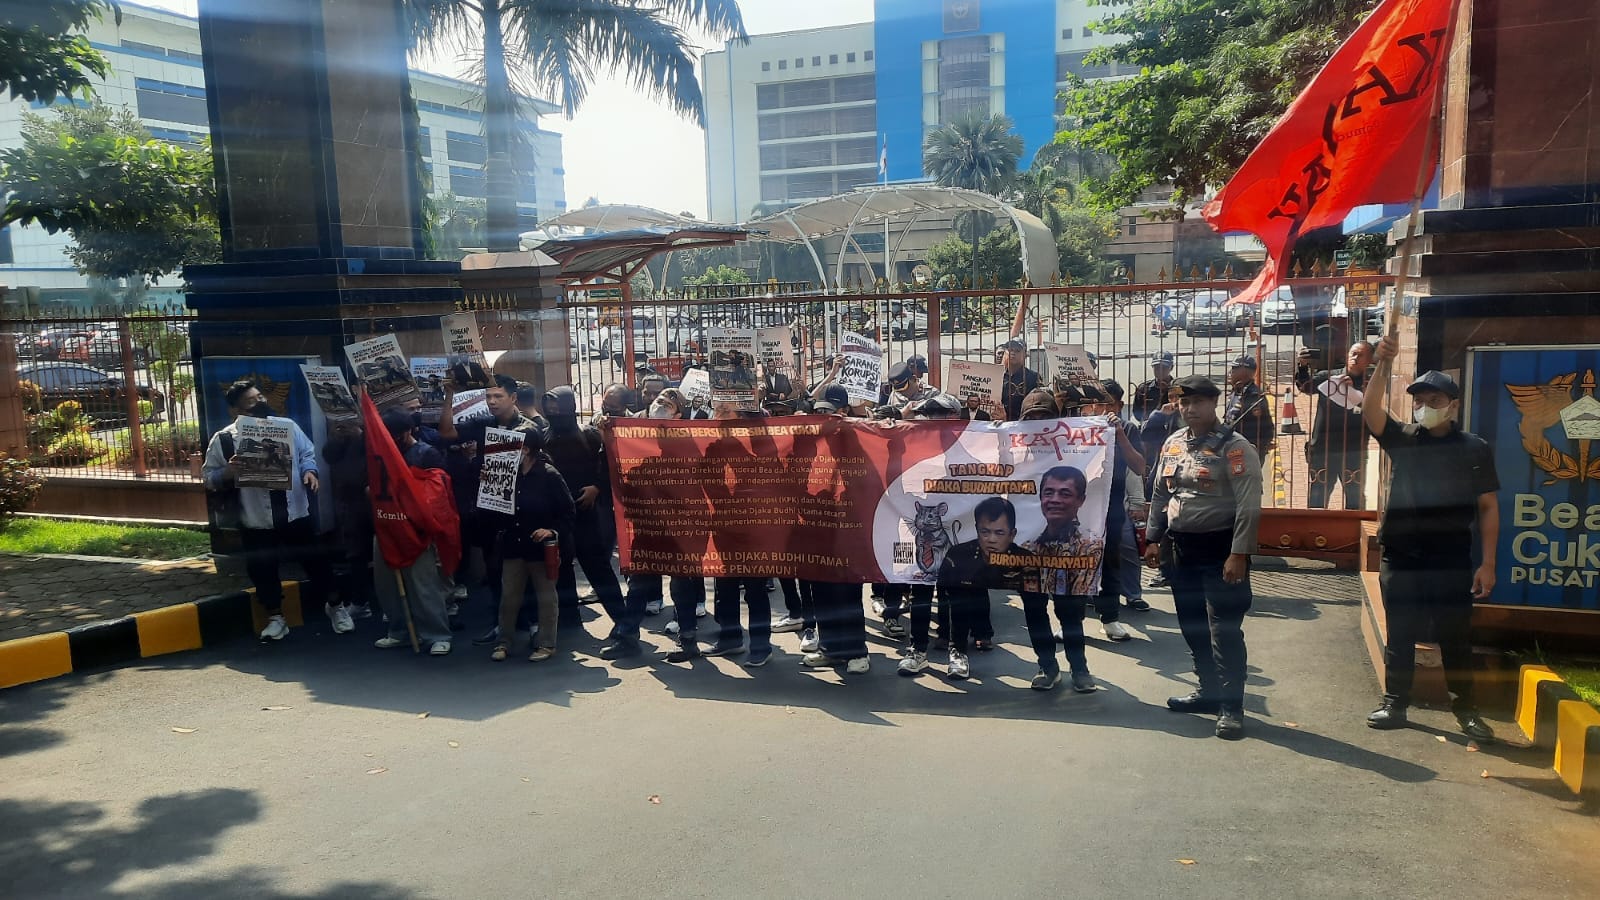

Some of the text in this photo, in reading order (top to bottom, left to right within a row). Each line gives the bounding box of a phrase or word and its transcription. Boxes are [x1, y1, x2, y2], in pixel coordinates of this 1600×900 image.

[845, 355, 880, 373] SARANG
[841, 366, 879, 385] KORUPSI
[962, 373, 992, 385] TANGKAP
[486, 432, 511, 444] GEDUNG
[611, 426, 665, 439] TUNTUTAN
[691, 426, 727, 440] BERSIH
[728, 426, 766, 438] BERSIH
[767, 425, 789, 436] BEA
[655, 455, 687, 464] Menteri
[841, 456, 865, 465] Budhi
[641, 466, 658, 475] dari
[659, 466, 690, 477] jabatan
[691, 466, 724, 476] Direktur
[758, 466, 773, 475] Bea
[774, 466, 789, 475] dan
[790, 466, 813, 475] Cukai
[814, 467, 833, 477] guna
[949, 463, 1015, 478] TANGKAP
[923, 478, 1037, 495] DJAKA BUDHI UTAMA
[657, 496, 684, 506] Komisi
[746, 495, 778, 507] Korupsi
[800, 495, 819, 504] dan
[653, 507, 676, 516] untuk
[748, 506, 772, 517] Djaka
[773, 505, 797, 515] Budhi
[797, 507, 822, 517] Utama
[724, 517, 772, 529] penerimaan
[773, 516, 796, 526] aliran
[839, 520, 864, 530] kasus
[676, 551, 700, 562] DAN
[703, 550, 732, 562] ADILI
[734, 551, 769, 564] DJAKA
[771, 551, 805, 563] BUDHI
[807, 553, 843, 568] UTAMA
[989, 552, 1041, 568] BURONAN
[1041, 555, 1088, 570] RAKYAT
[628, 561, 650, 572] BEA
[651, 562, 681, 573] CUKAI
[682, 563, 727, 575] SARANG
[729, 563, 791, 576] PENYAMUN
[1510, 566, 1599, 588] PUSAT
